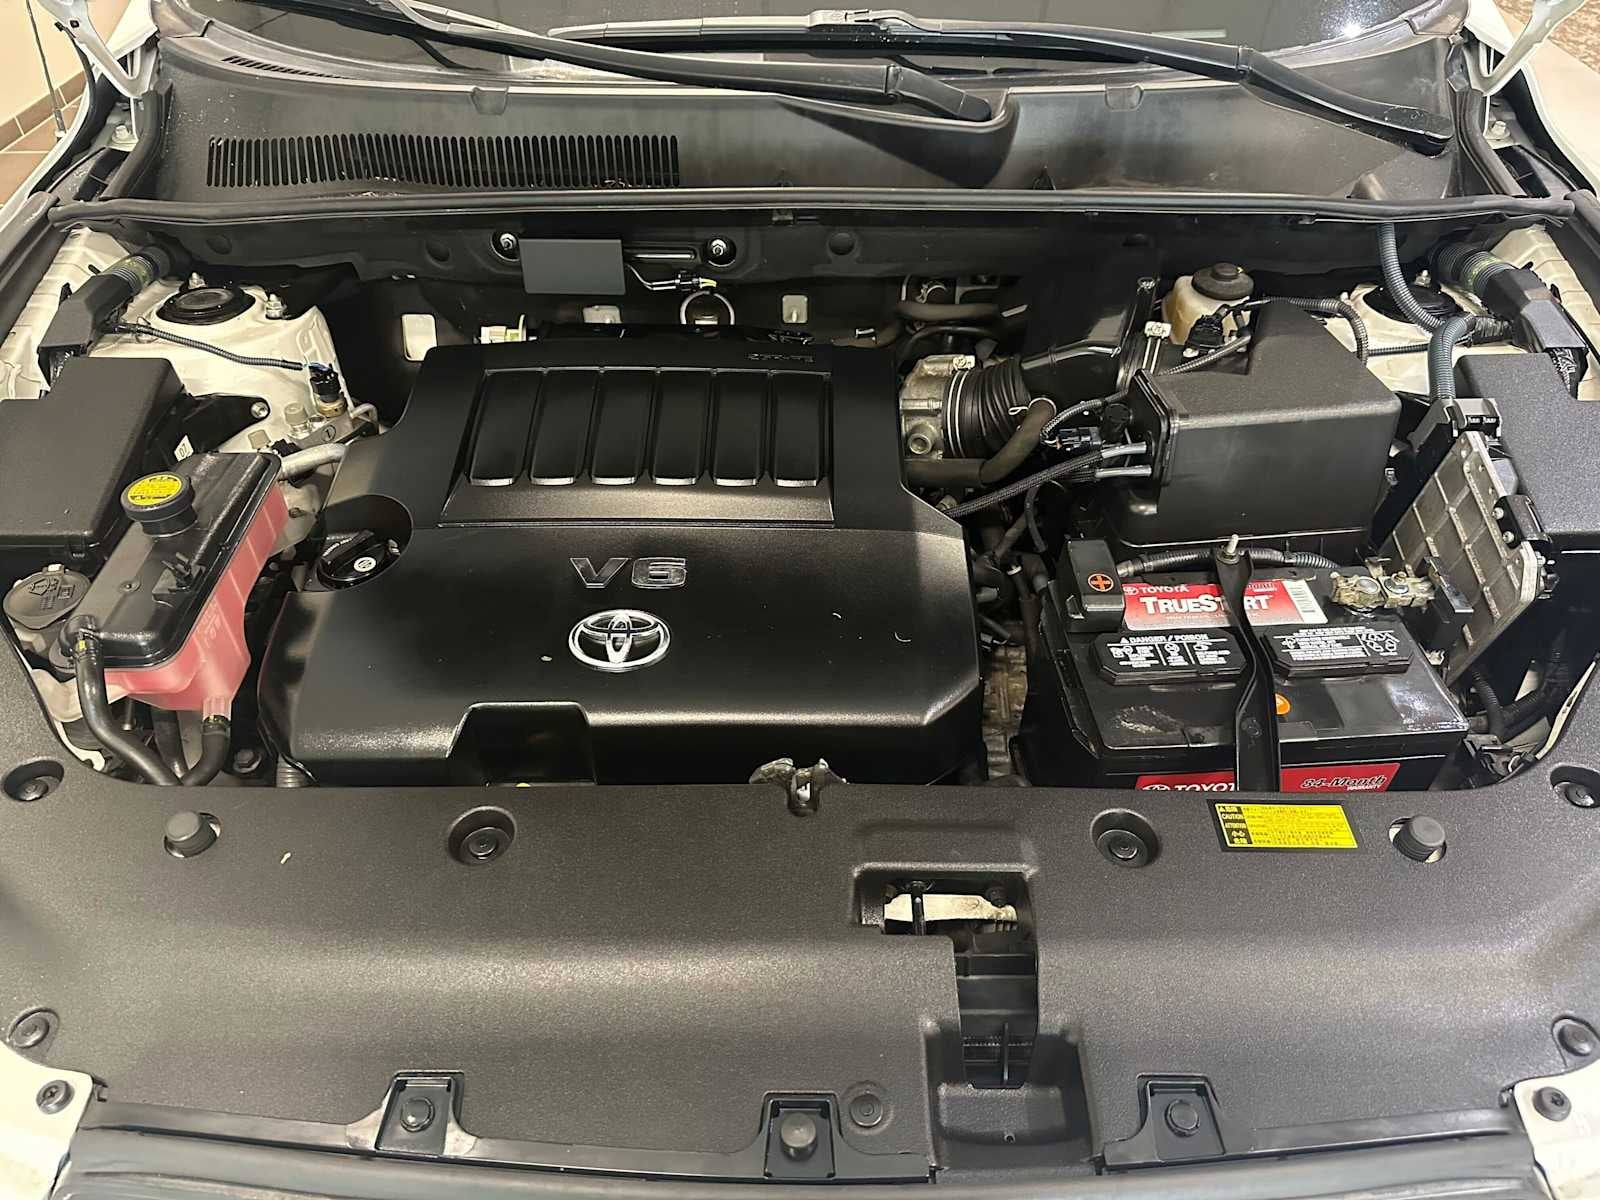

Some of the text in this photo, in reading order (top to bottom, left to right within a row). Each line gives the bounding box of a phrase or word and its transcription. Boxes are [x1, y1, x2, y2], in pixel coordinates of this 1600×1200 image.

[570, 557, 687, 589] V6
[1141, 584, 1189, 594] TOYOTA
[1139, 594, 1272, 614] TRUESRT
